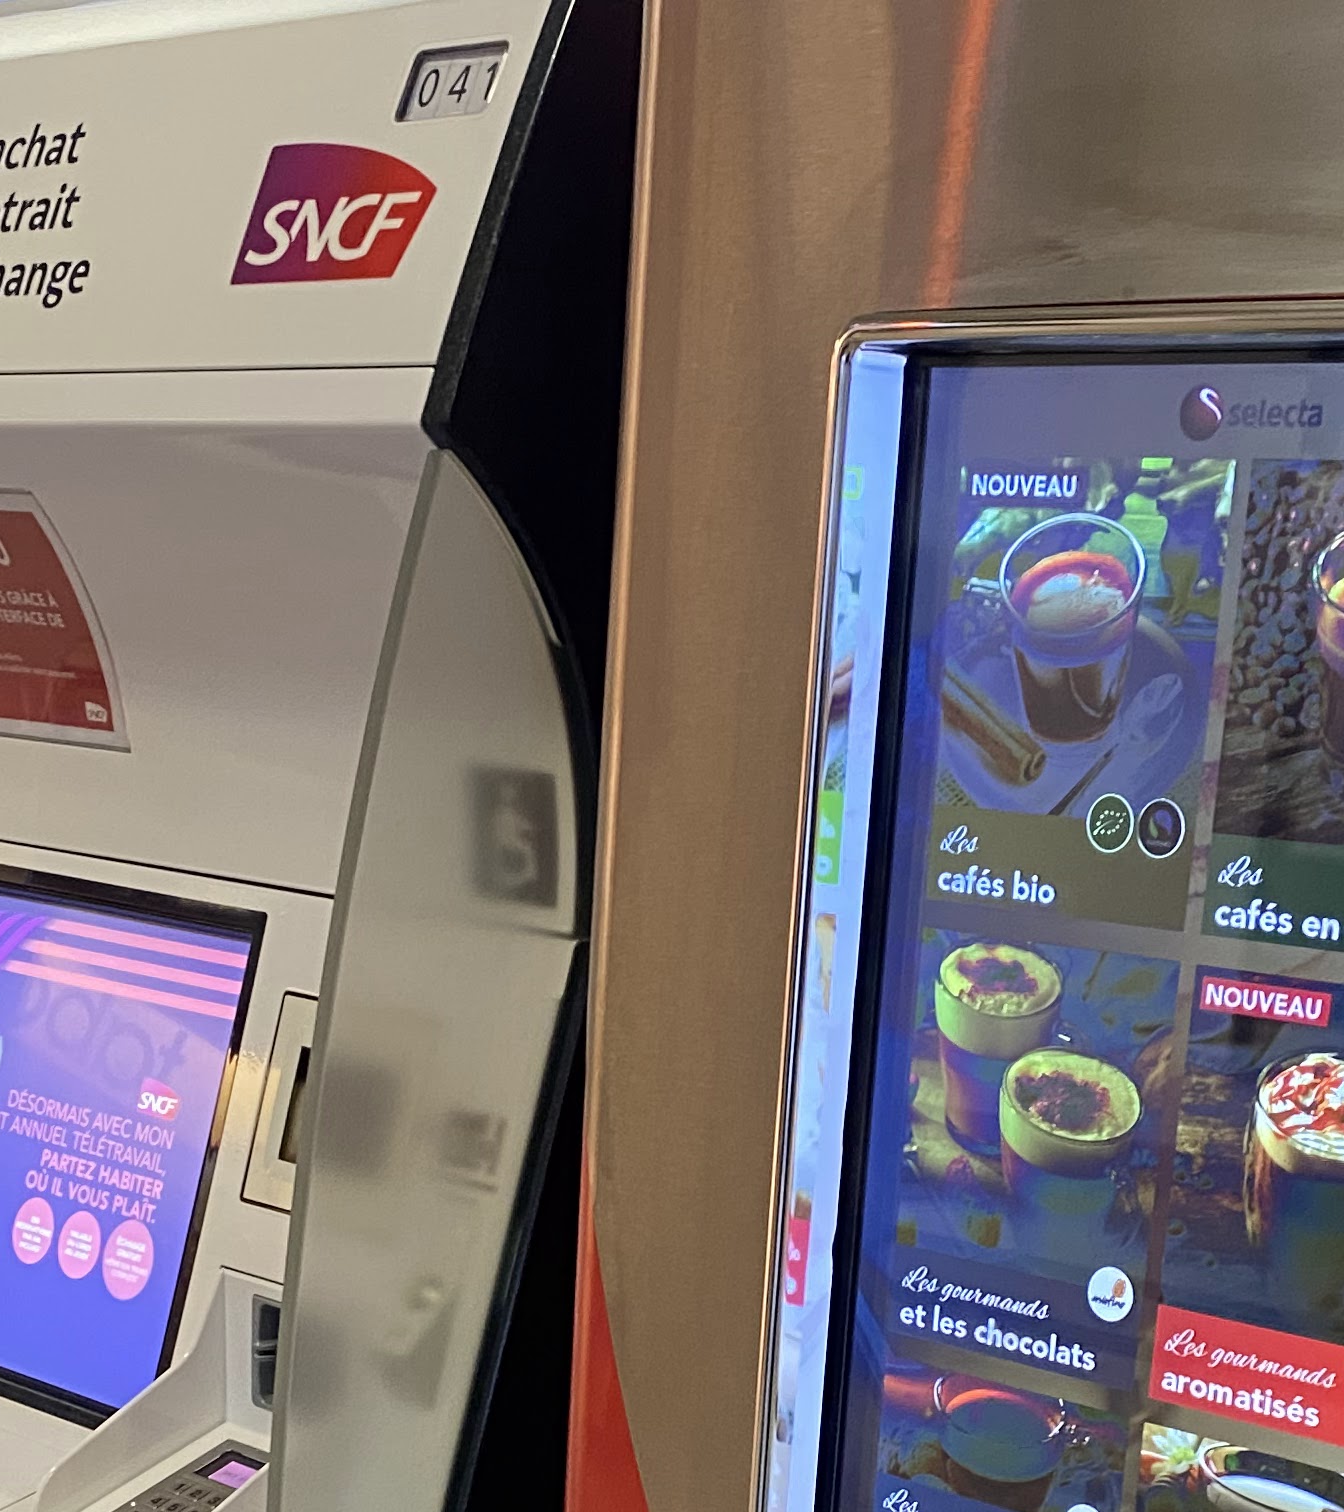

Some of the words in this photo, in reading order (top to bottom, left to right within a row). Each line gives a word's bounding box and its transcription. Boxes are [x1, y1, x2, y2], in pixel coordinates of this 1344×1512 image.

[245, 189, 423, 268] SNCF
[1227, 400, 1323, 429] selecta
[972, 473, 1078, 499] NOUVEAU
[47, 613, 65, 627] DE
[940, 825, 979, 855] Les
[938, 867, 1006, 898] cafés
[1012, 871, 1056, 904] bio
[1218, 855, 1263, 888] Les
[1214, 901, 1294, 937] cafés
[1301, 914, 1340, 941] en
[1204, 984, 1324, 1019] NOUVEAU
[8, 1087, 92, 1128] DÉSORMAIS
[93, 1110, 133, 1140] AVEC
[134, 1121, 175, 1150] MON
[137, 1088, 179, 1117] SNCF
[9, 1114, 69, 1148] ANNUEL
[69, 1122, 167, 1177] TÉLÉTRAVAIL,
[25, 1168, 48, 1192] OÙ
[50, 1177, 63, 1197] IL
[68, 1181, 110, 1210] VOUS
[111, 1193, 158, 1224] PLAÎT.
[40, 1148, 94, 1182] PARTEZ
[99, 1166, 164, 1201] HABITER
[901, 1265, 940, 1296] Les
[942, 1279, 1050, 1321] gourmands
[900, 1304, 925, 1330] et
[932, 1305, 967, 1339] les
[975, 1317, 1097, 1372] chocolats
[1164, 1329, 1207, 1358] Les
[1210, 1345, 1337, 1389] gourmands
[1161, 1368, 1321, 1428] aromatisés
